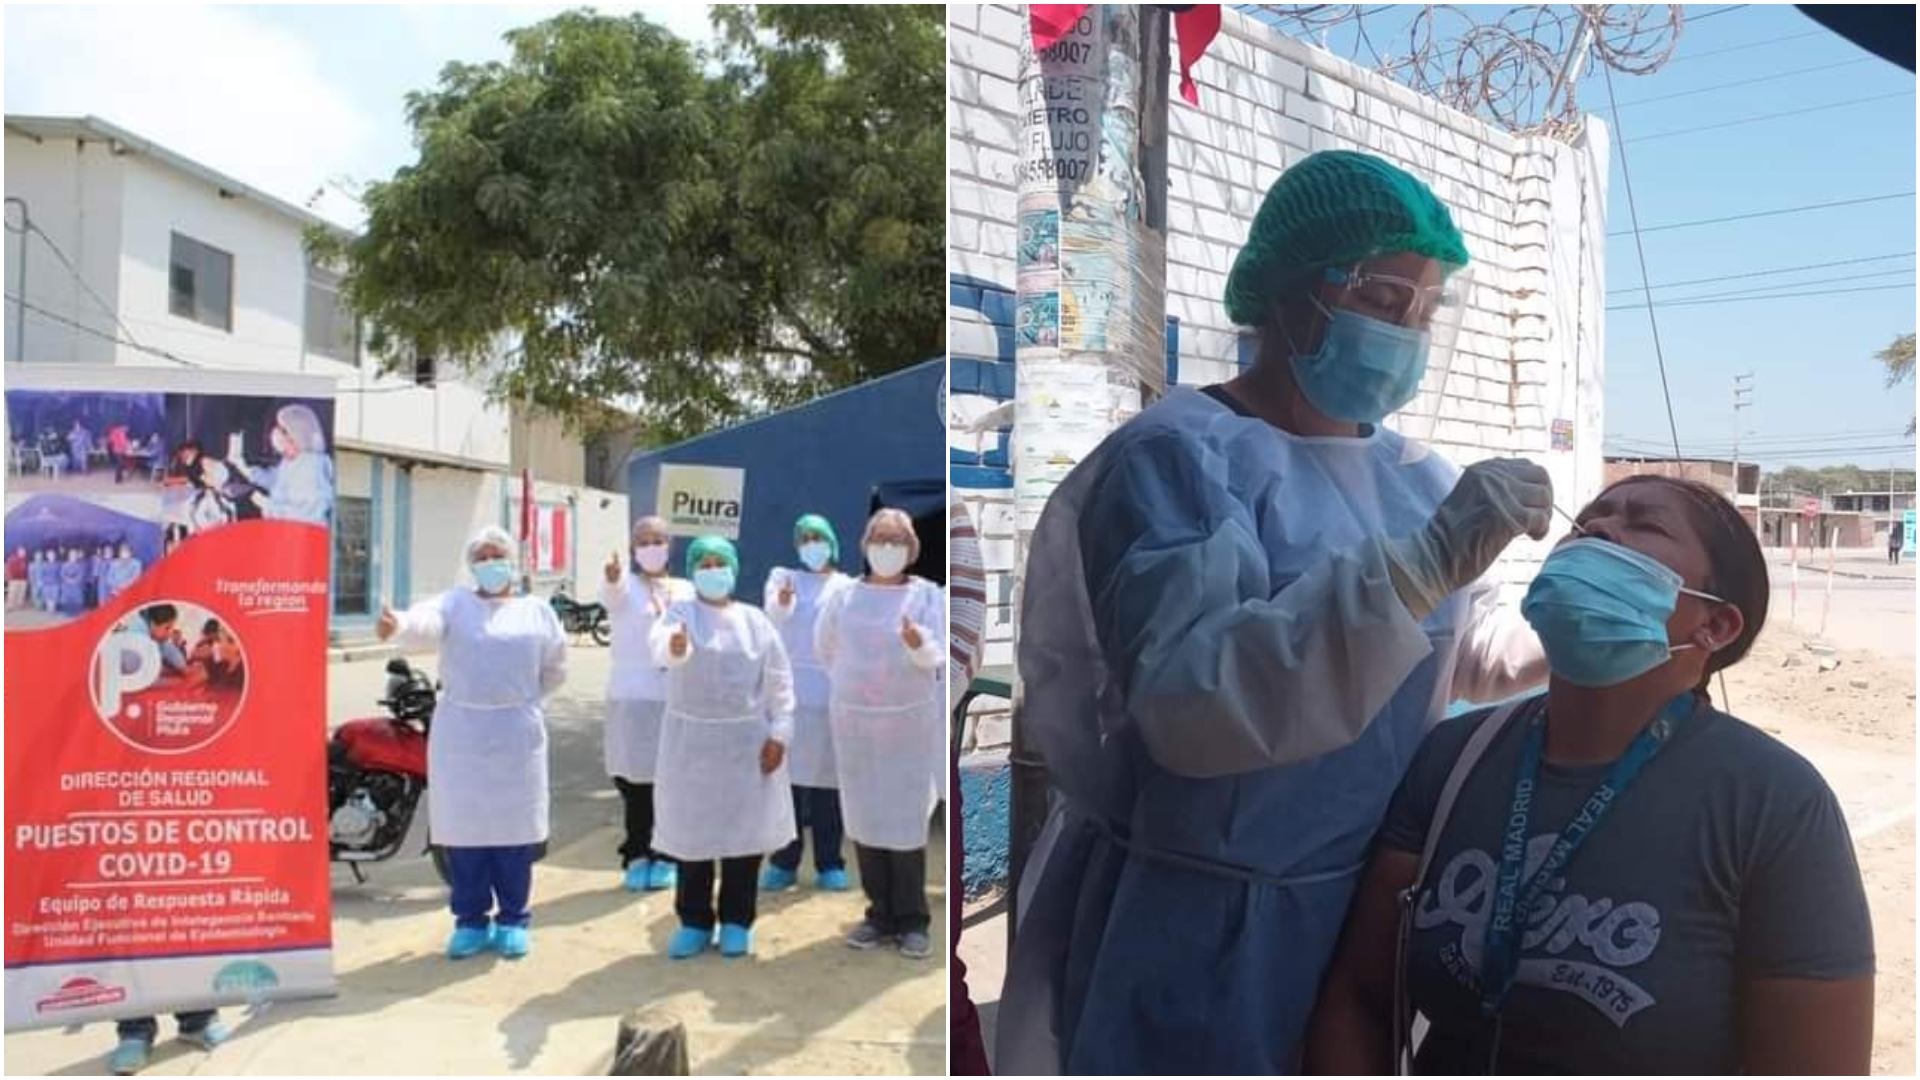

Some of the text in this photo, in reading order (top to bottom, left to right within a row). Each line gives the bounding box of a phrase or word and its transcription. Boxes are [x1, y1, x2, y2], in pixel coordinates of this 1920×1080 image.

[673, 491, 738, 518] Piura
[61, 768, 269, 791] DIRECCIÓN REGIONAL
[119, 789, 213, 807] DE SALUD
[1565, 784, 1616, 834] REAL
[16, 817, 312, 849] PUESTOS DE CONTROL
[98, 850, 233, 878] COVID-19
[1493, 778, 1533, 931] REAL MADRID
[39, 886, 290, 915] Equipo de Respuesta Rápida
